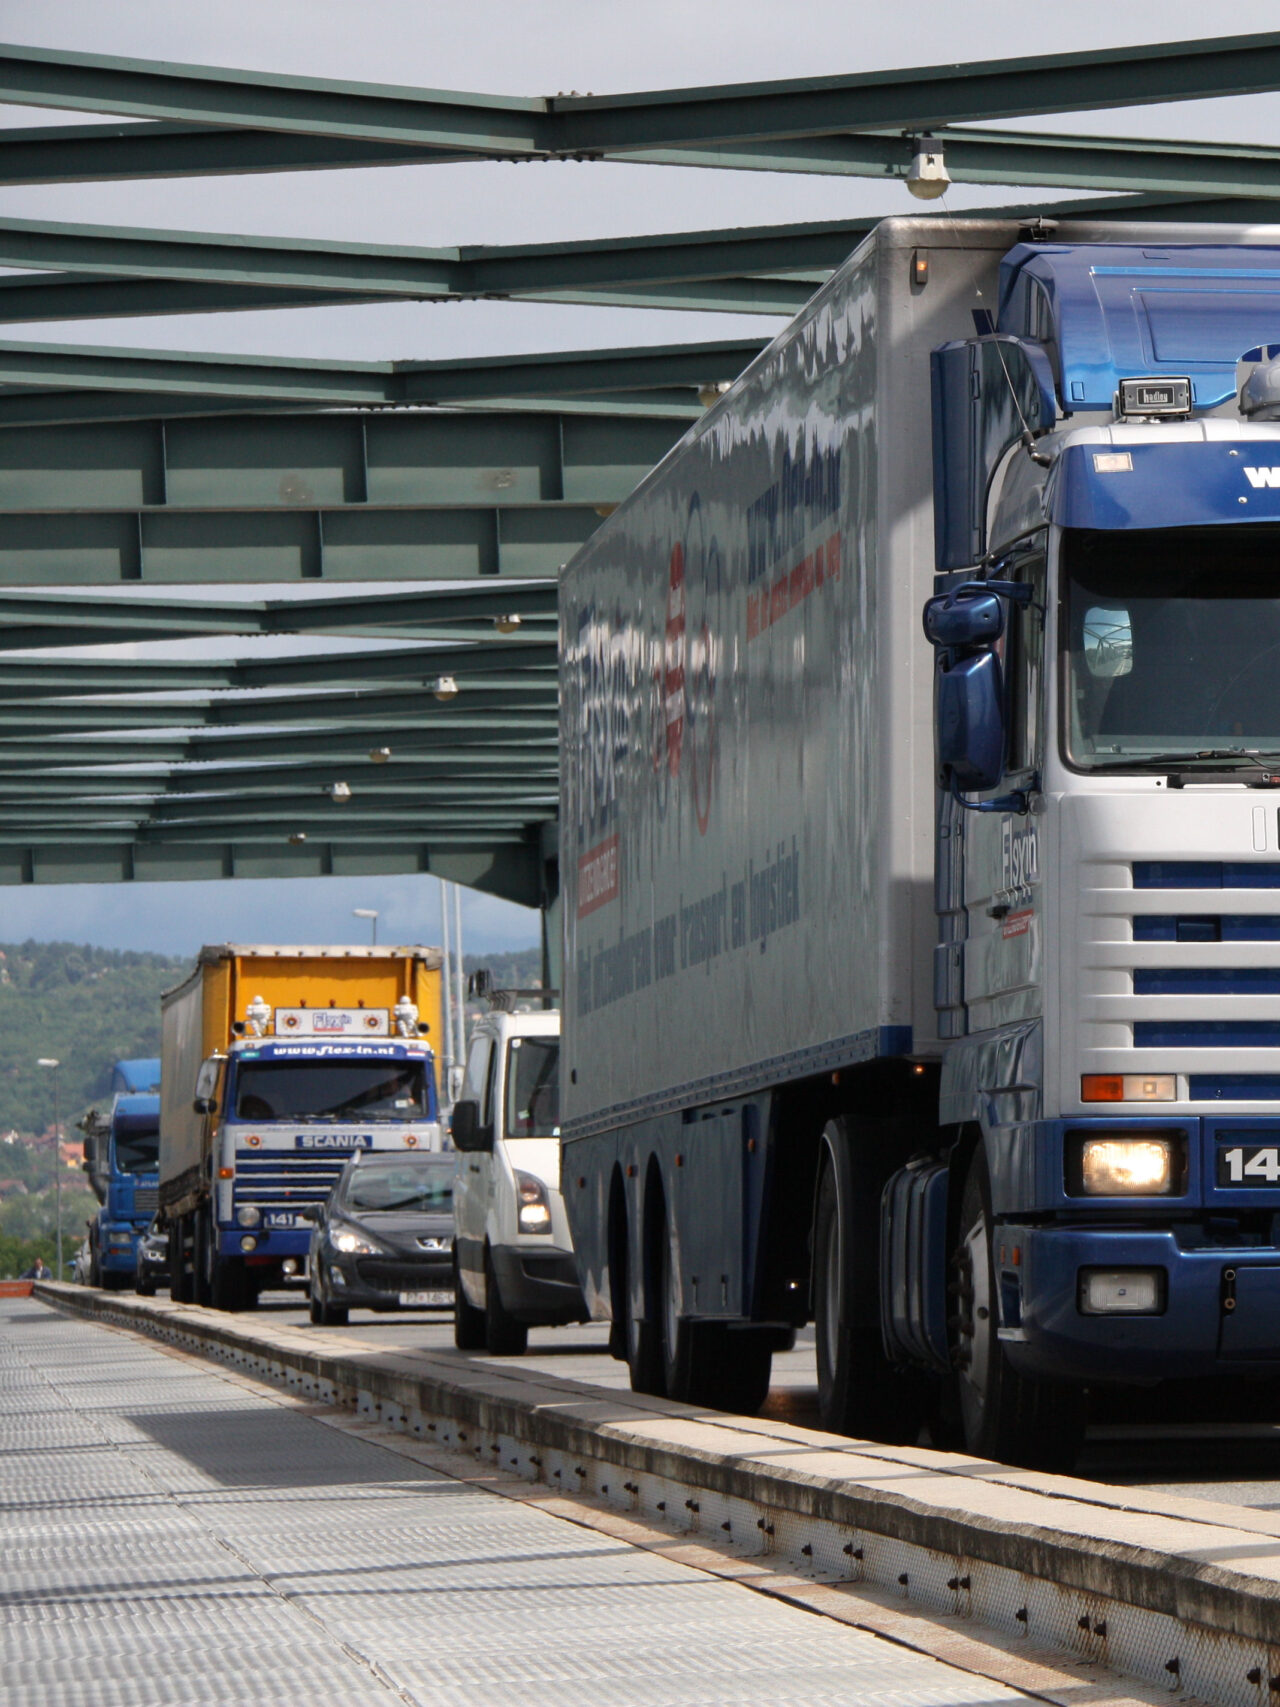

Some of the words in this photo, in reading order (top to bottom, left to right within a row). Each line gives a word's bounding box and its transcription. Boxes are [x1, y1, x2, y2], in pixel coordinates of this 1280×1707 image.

[1143, 388, 1168, 403] hadley
[303, 1136, 367, 1148] SCANIA
[270, 1213, 294, 1226] 141
